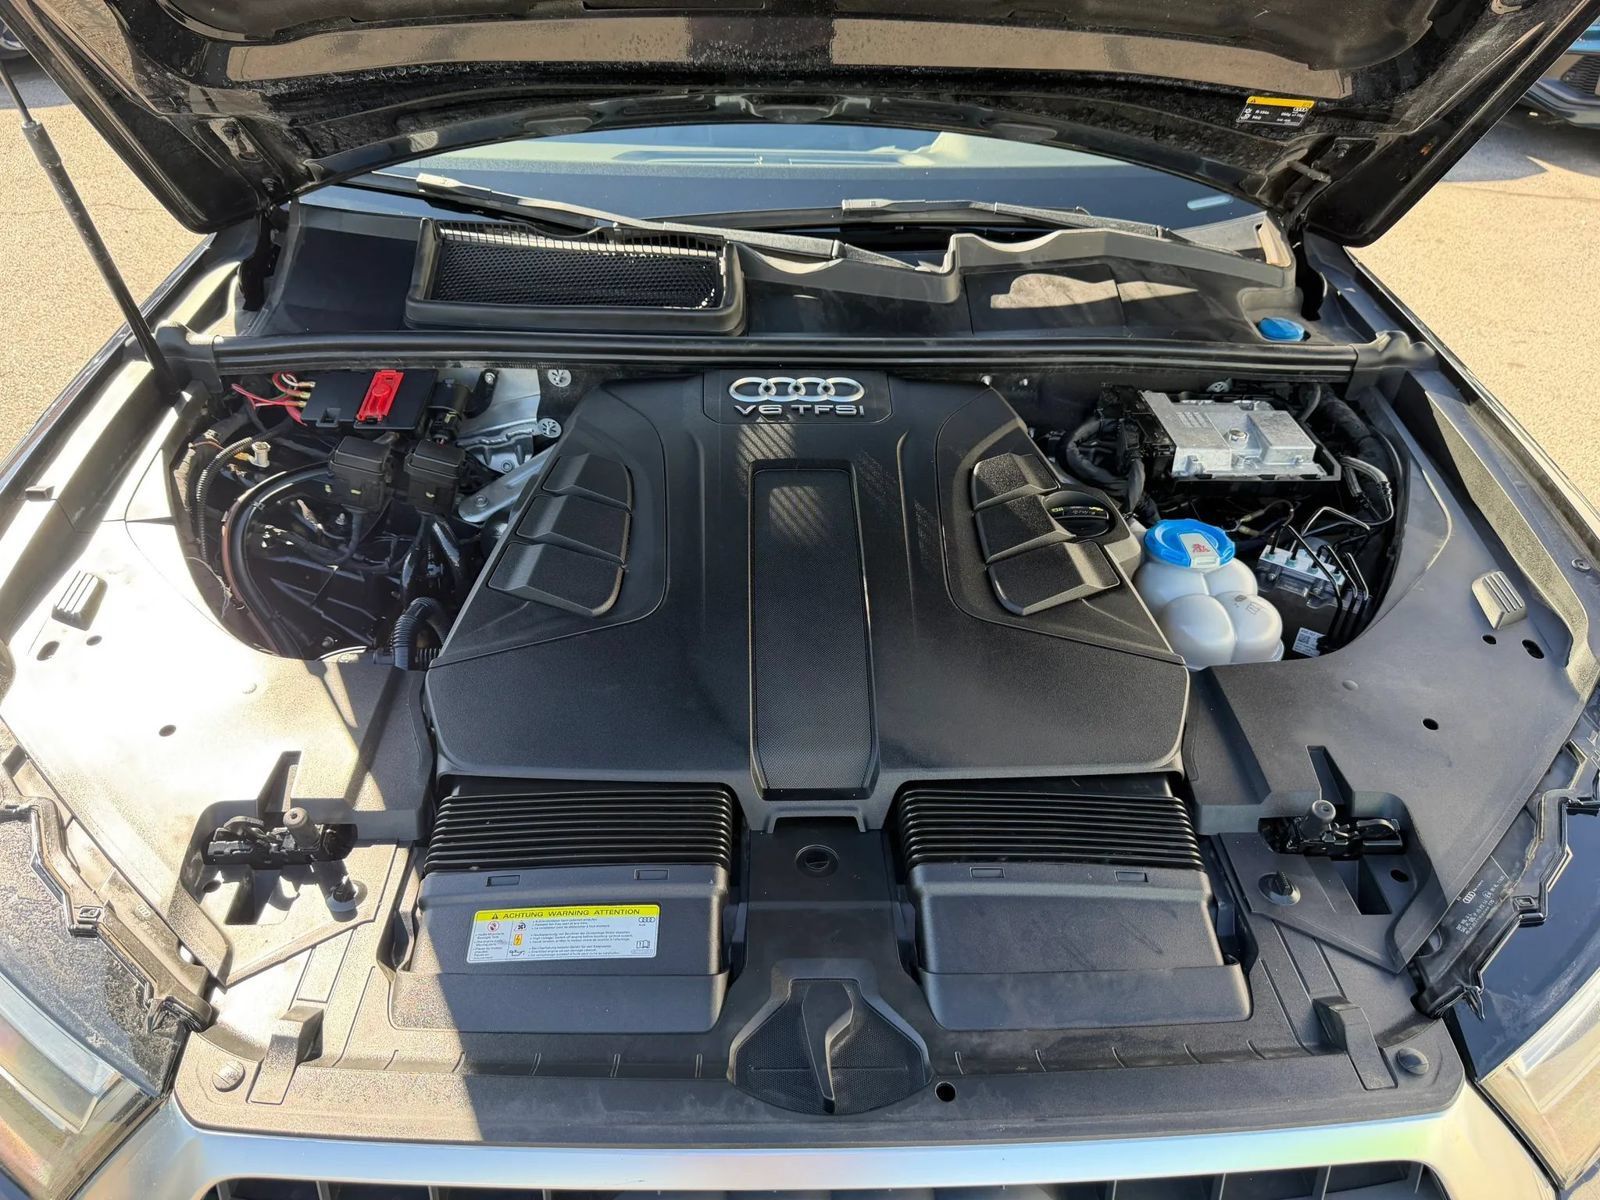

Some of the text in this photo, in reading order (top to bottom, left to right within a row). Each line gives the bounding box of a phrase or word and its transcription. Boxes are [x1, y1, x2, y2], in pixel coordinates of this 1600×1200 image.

[734, 404, 865, 415] V6 TFSI
[548, 909, 589, 917] WARNING
